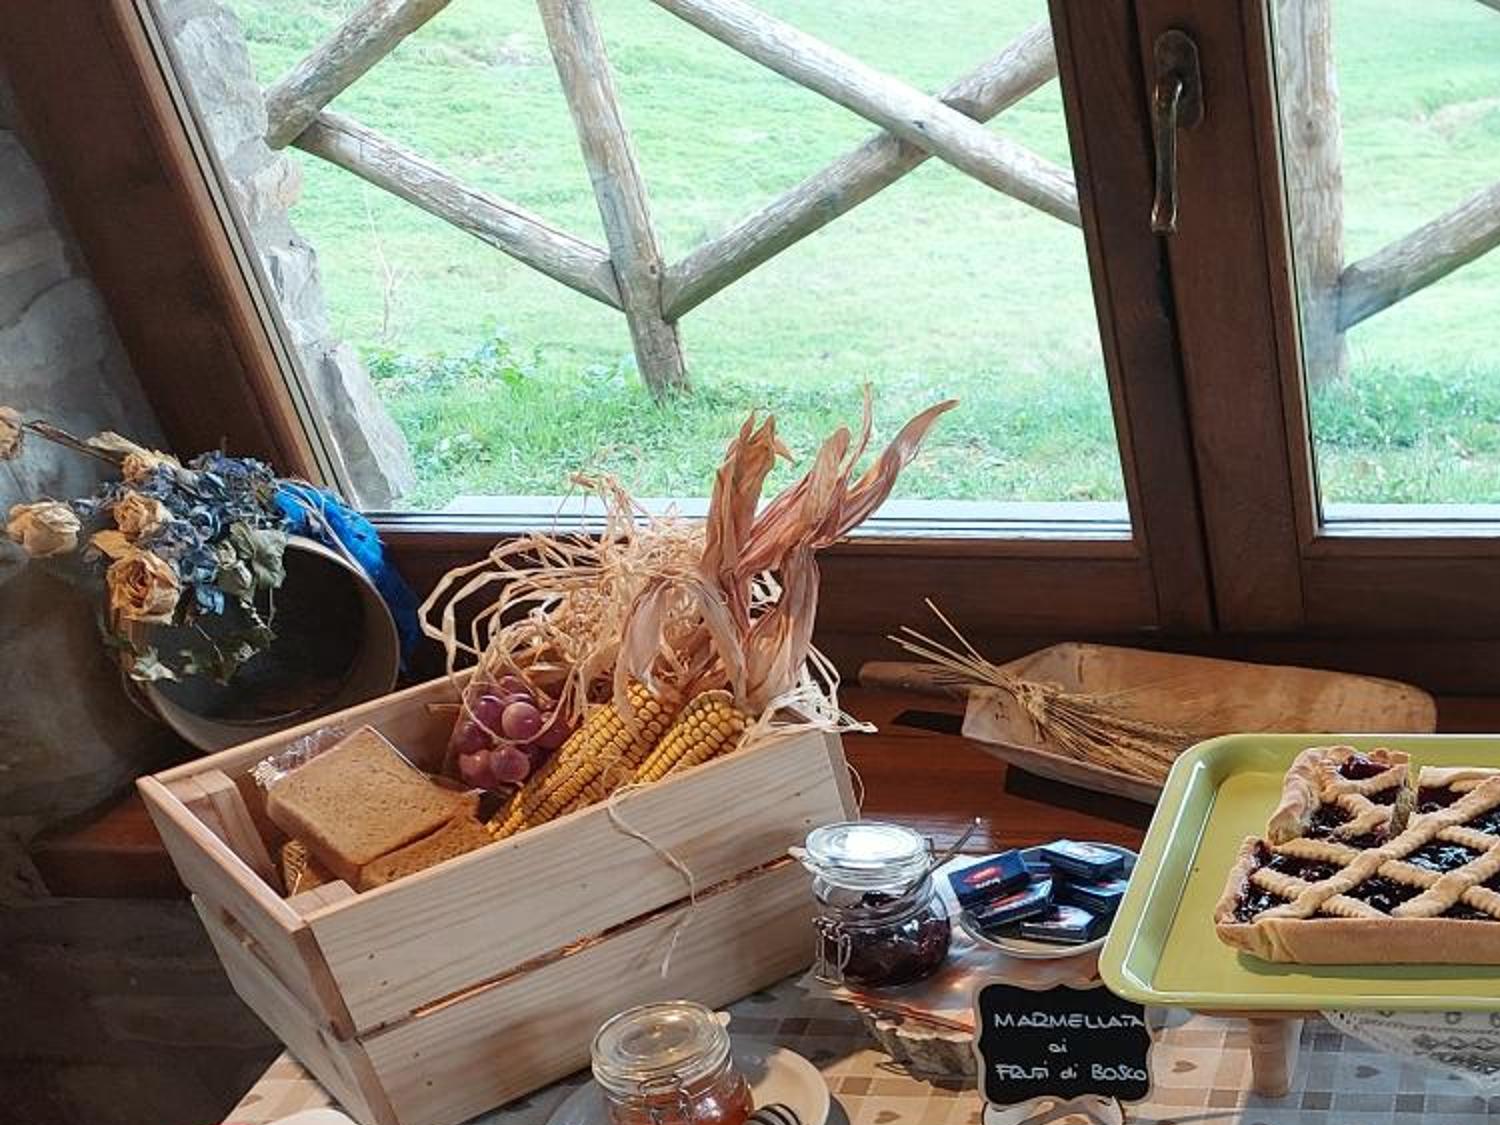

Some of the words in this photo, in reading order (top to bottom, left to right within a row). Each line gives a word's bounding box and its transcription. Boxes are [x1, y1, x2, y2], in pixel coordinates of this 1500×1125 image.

[994, 1011, 1145, 1029] MARMELLATA
[1060, 1062, 1079, 1080] di
[1091, 1063, 1148, 1081] BOSCO
